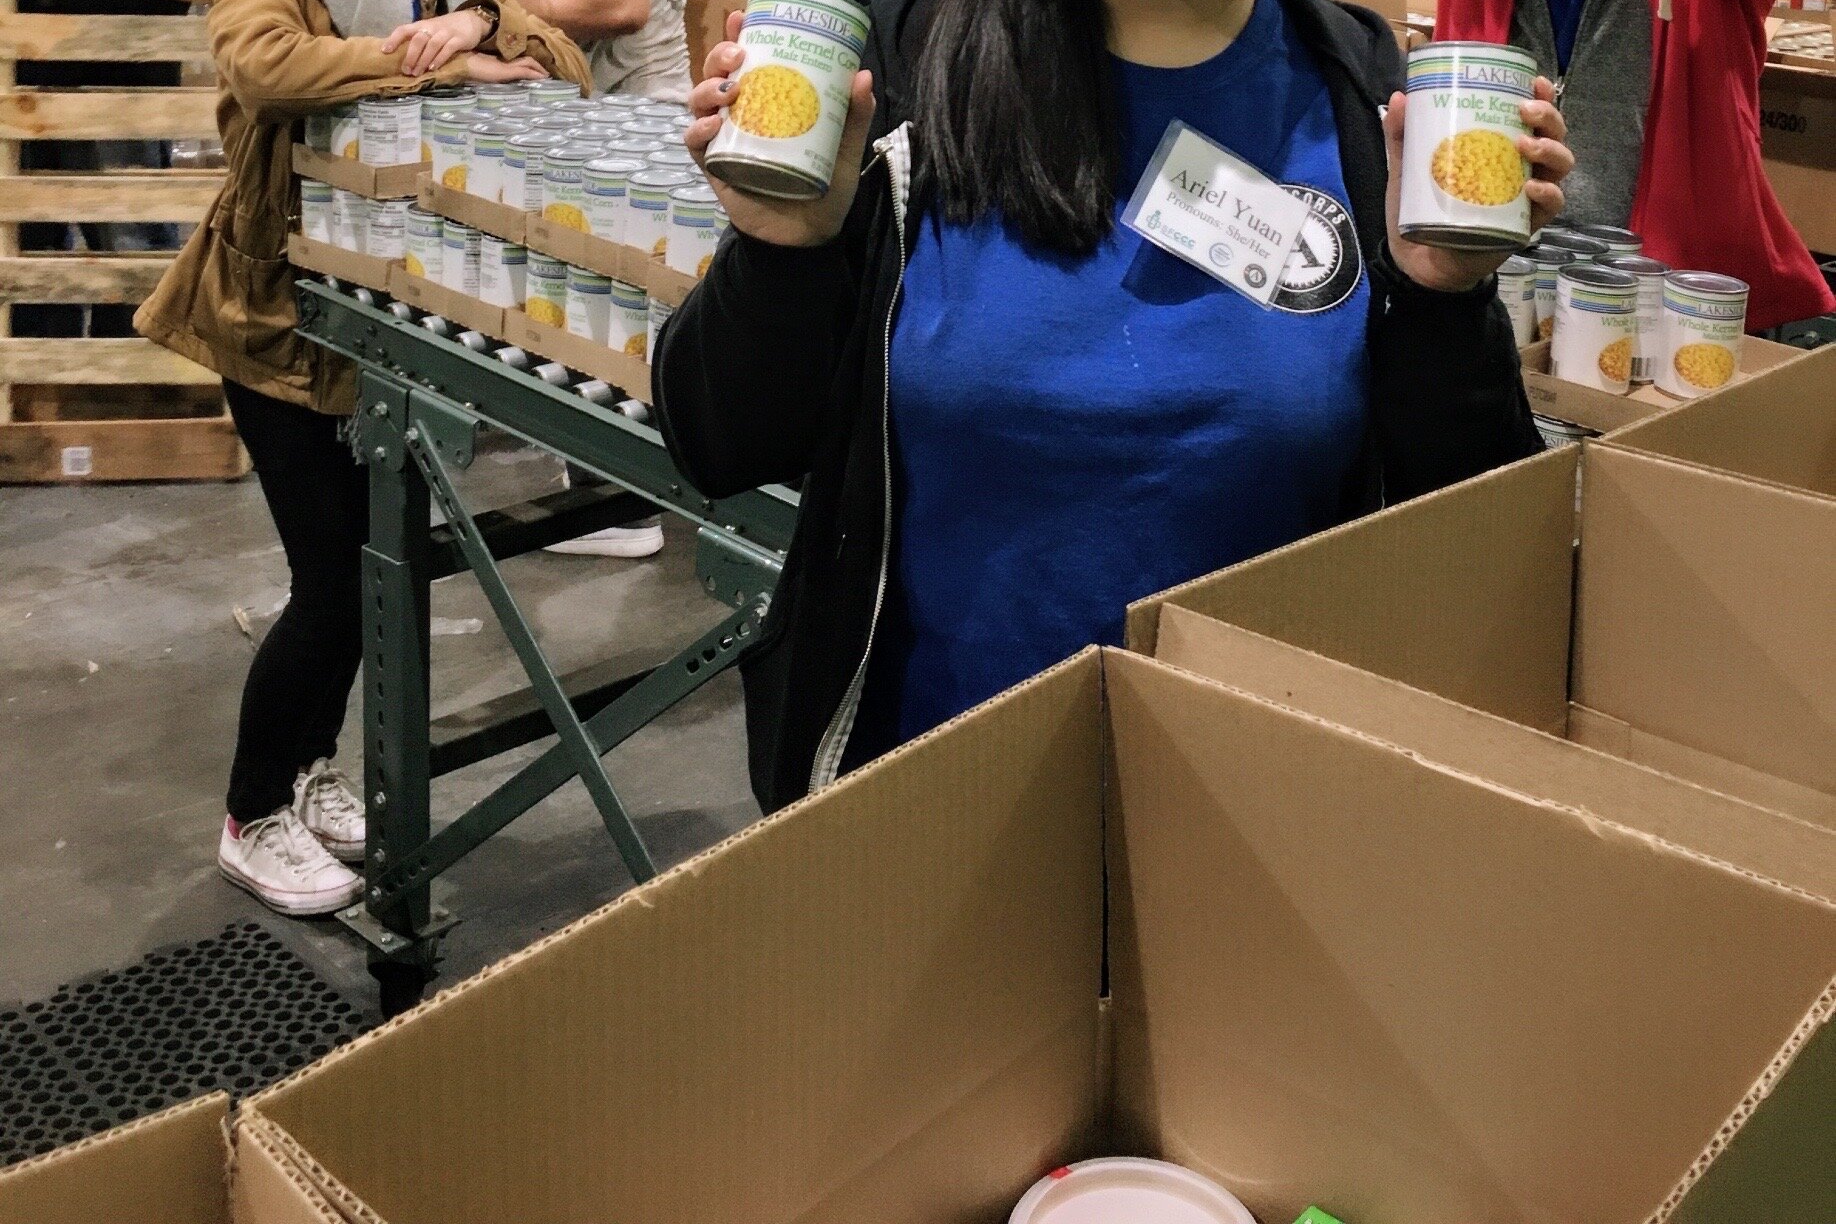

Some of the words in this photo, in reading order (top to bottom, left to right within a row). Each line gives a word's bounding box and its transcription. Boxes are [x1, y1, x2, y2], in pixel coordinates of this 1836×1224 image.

[773, 3, 853, 36] LAKESIDE
[745, 30, 785, 46] Whole
[788, 33, 836, 59] Kernel
[1489, 96, 1520, 115] Kern
[1170, 169, 1227, 208] Ariel
[1233, 197, 1283, 246] Yuan
[1166, 191, 1225, 231] Pronouns:
[1225, 224, 1271, 260] She/Her
